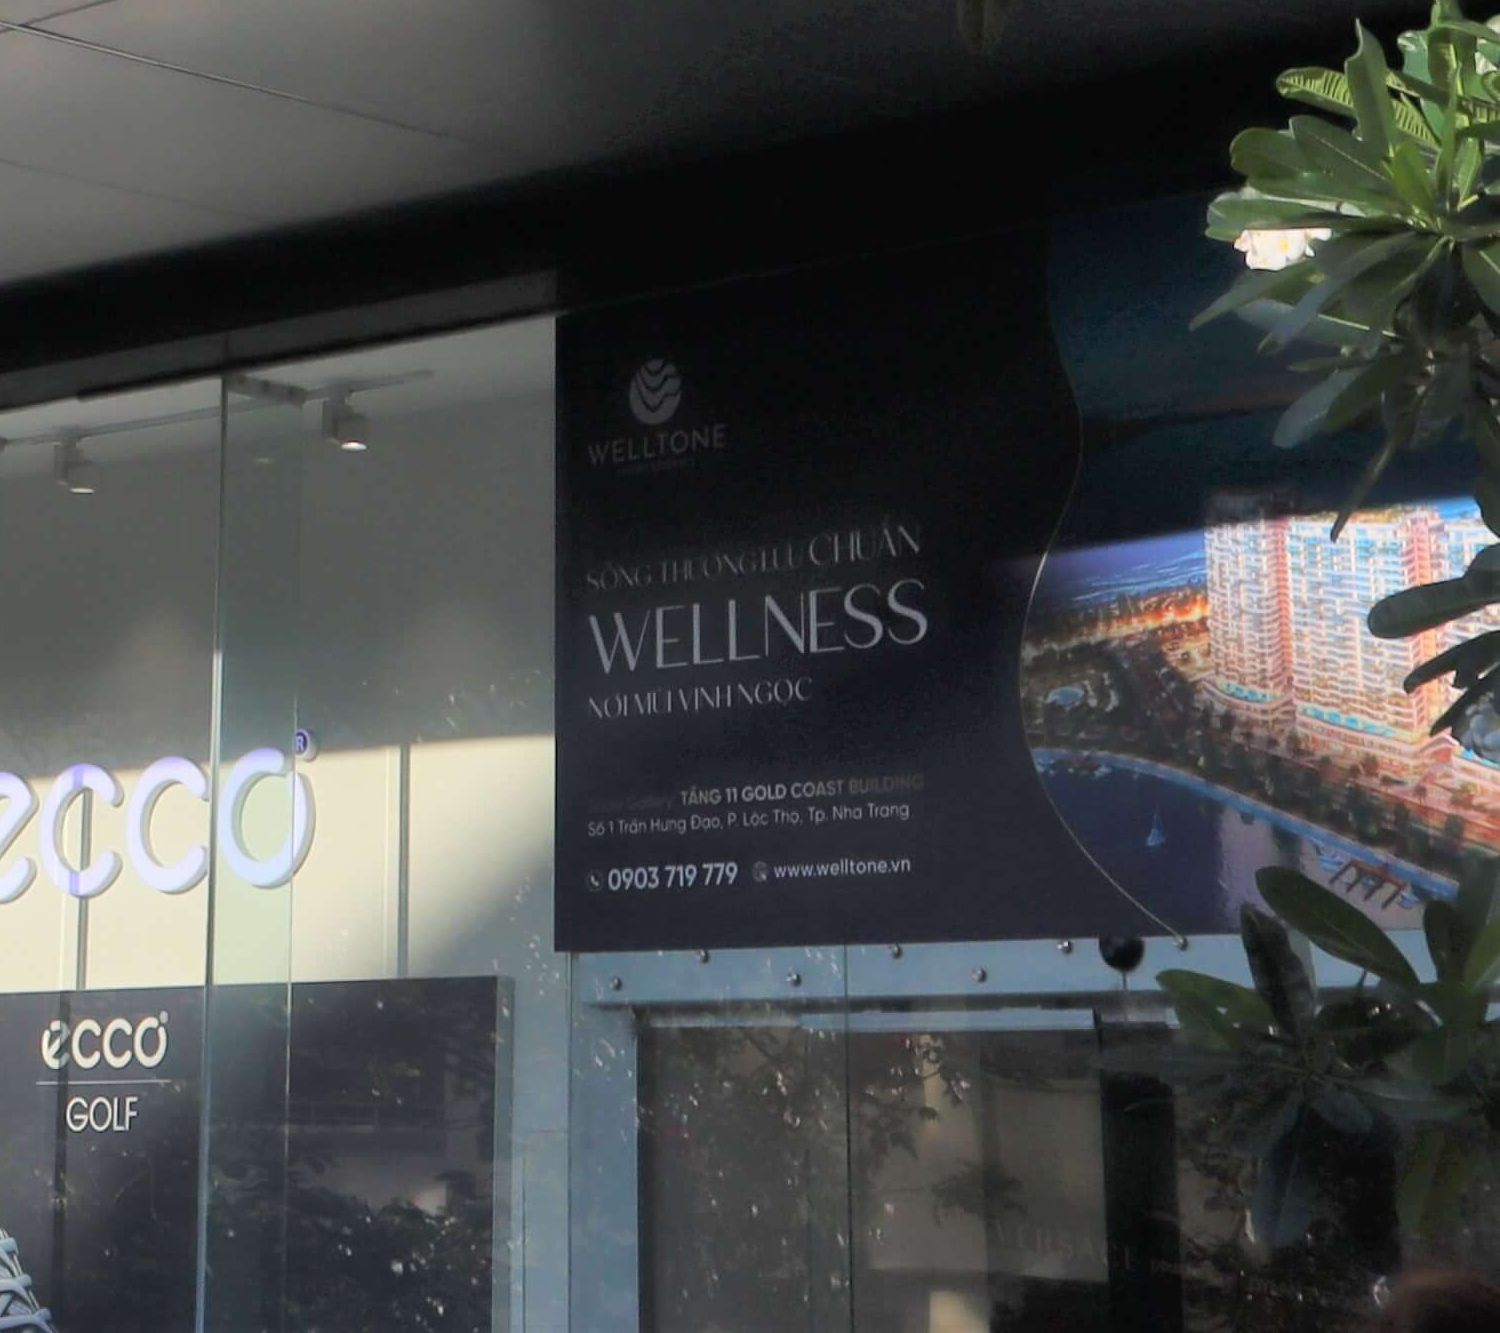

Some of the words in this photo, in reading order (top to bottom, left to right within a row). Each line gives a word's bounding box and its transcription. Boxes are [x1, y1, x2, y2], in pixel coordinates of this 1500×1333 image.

[588, 424, 727, 465] WELLTONE
[589, 578, 929, 674] WELLNESS
[726, 787, 738, 803] 11
[742, 785, 786, 802] GOLD
[791, 780, 842, 798] COAST
[850, 774, 924, 794] BUILDING
[833, 803, 862, 820] Nha
[868, 802, 910, 820] Trang
[608, 866, 659, 890] 0903
[665, 864, 697, 887] 719
[702, 862, 738, 886] 779
[774, 859, 911, 880] www.welltone.vn
[41, 1012, 168, 1070] ecco
[66, 1095, 140, 1133] GOLF
